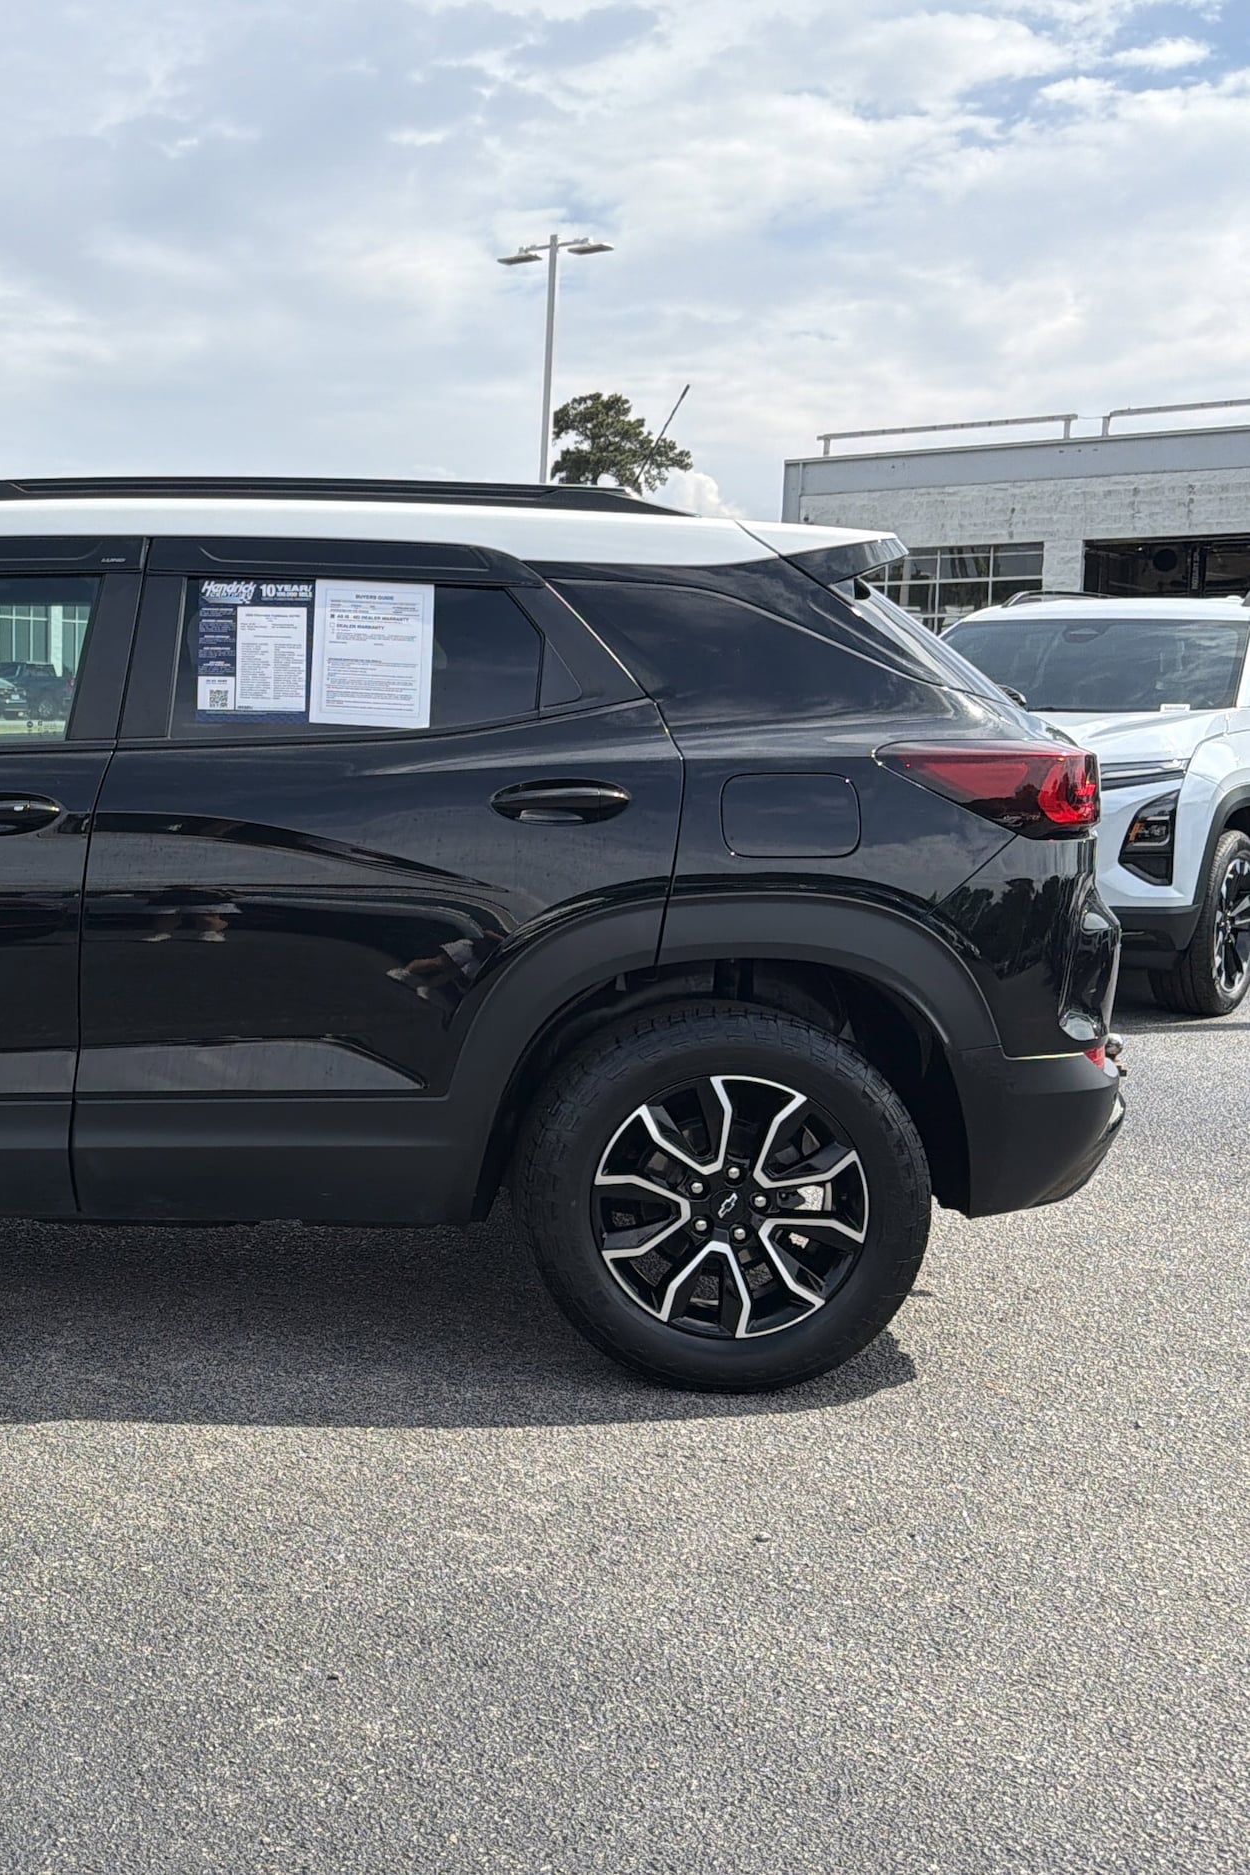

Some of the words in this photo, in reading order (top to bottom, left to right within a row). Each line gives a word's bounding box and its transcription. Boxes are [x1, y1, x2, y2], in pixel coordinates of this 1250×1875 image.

[201, 580, 257, 597] Hendrick
[260, 583, 276, 598] 10
[276, 584, 313, 592] YEAR/
